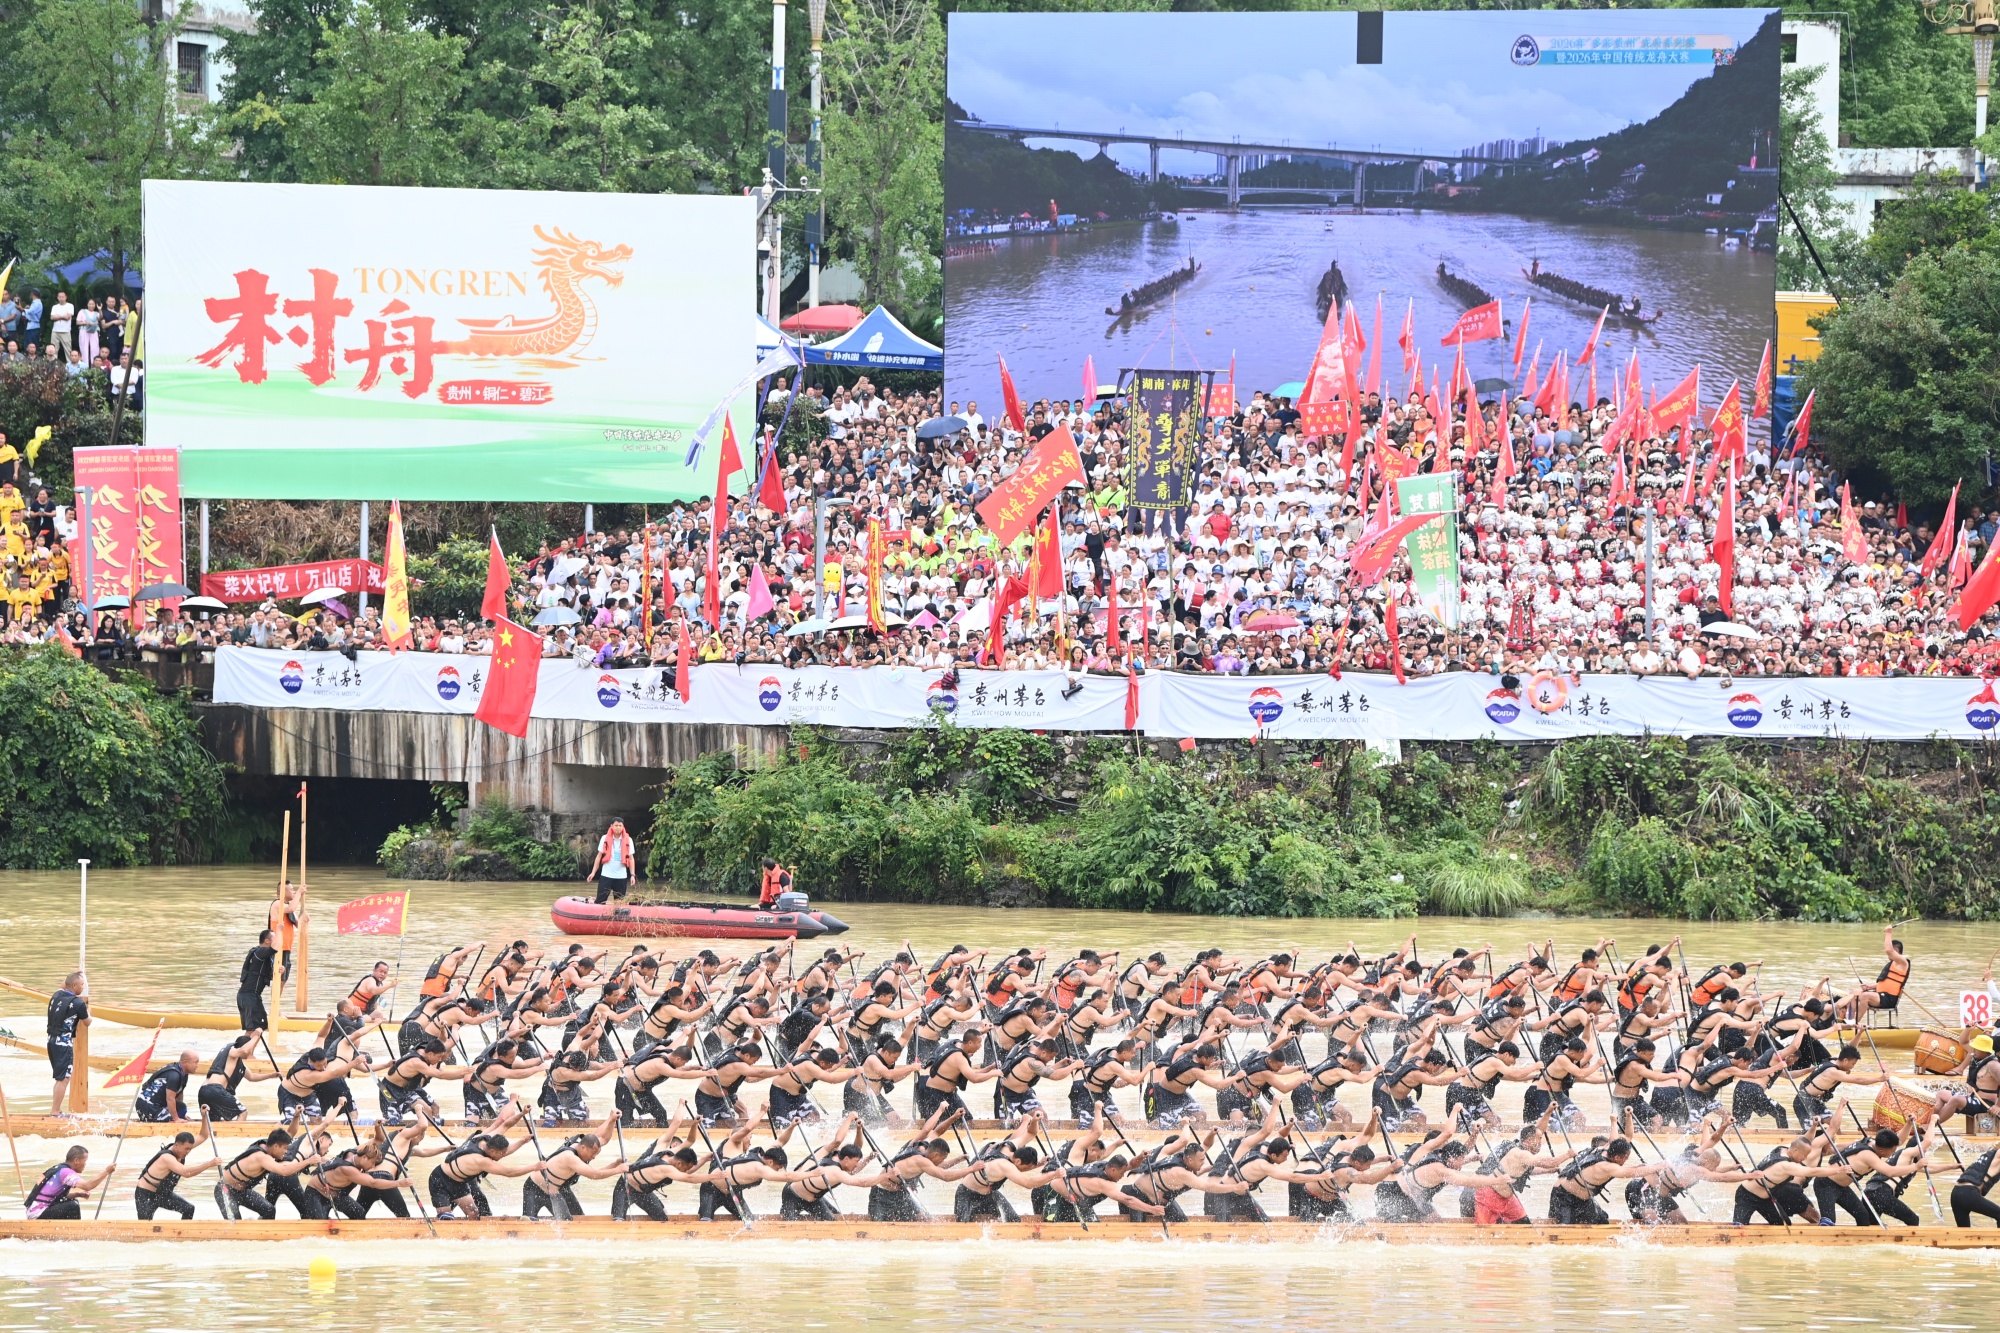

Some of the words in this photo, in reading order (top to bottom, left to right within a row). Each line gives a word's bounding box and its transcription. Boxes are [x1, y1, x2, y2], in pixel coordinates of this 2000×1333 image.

[353, 267, 528, 297] TONGREN
[187, 268, 445, 399] 村舟
[224, 563, 385, 598] 柴火记忆（万山店）祝
[968, 682, 1046, 707] 贵州茅台
[1773, 694, 1851, 720] 贵州茅台
[1490, 710, 1515, 718] MOUTAI
[1731, 714, 1758, 722] MOUTAI
[1963, 993, 1989, 1027] 38
